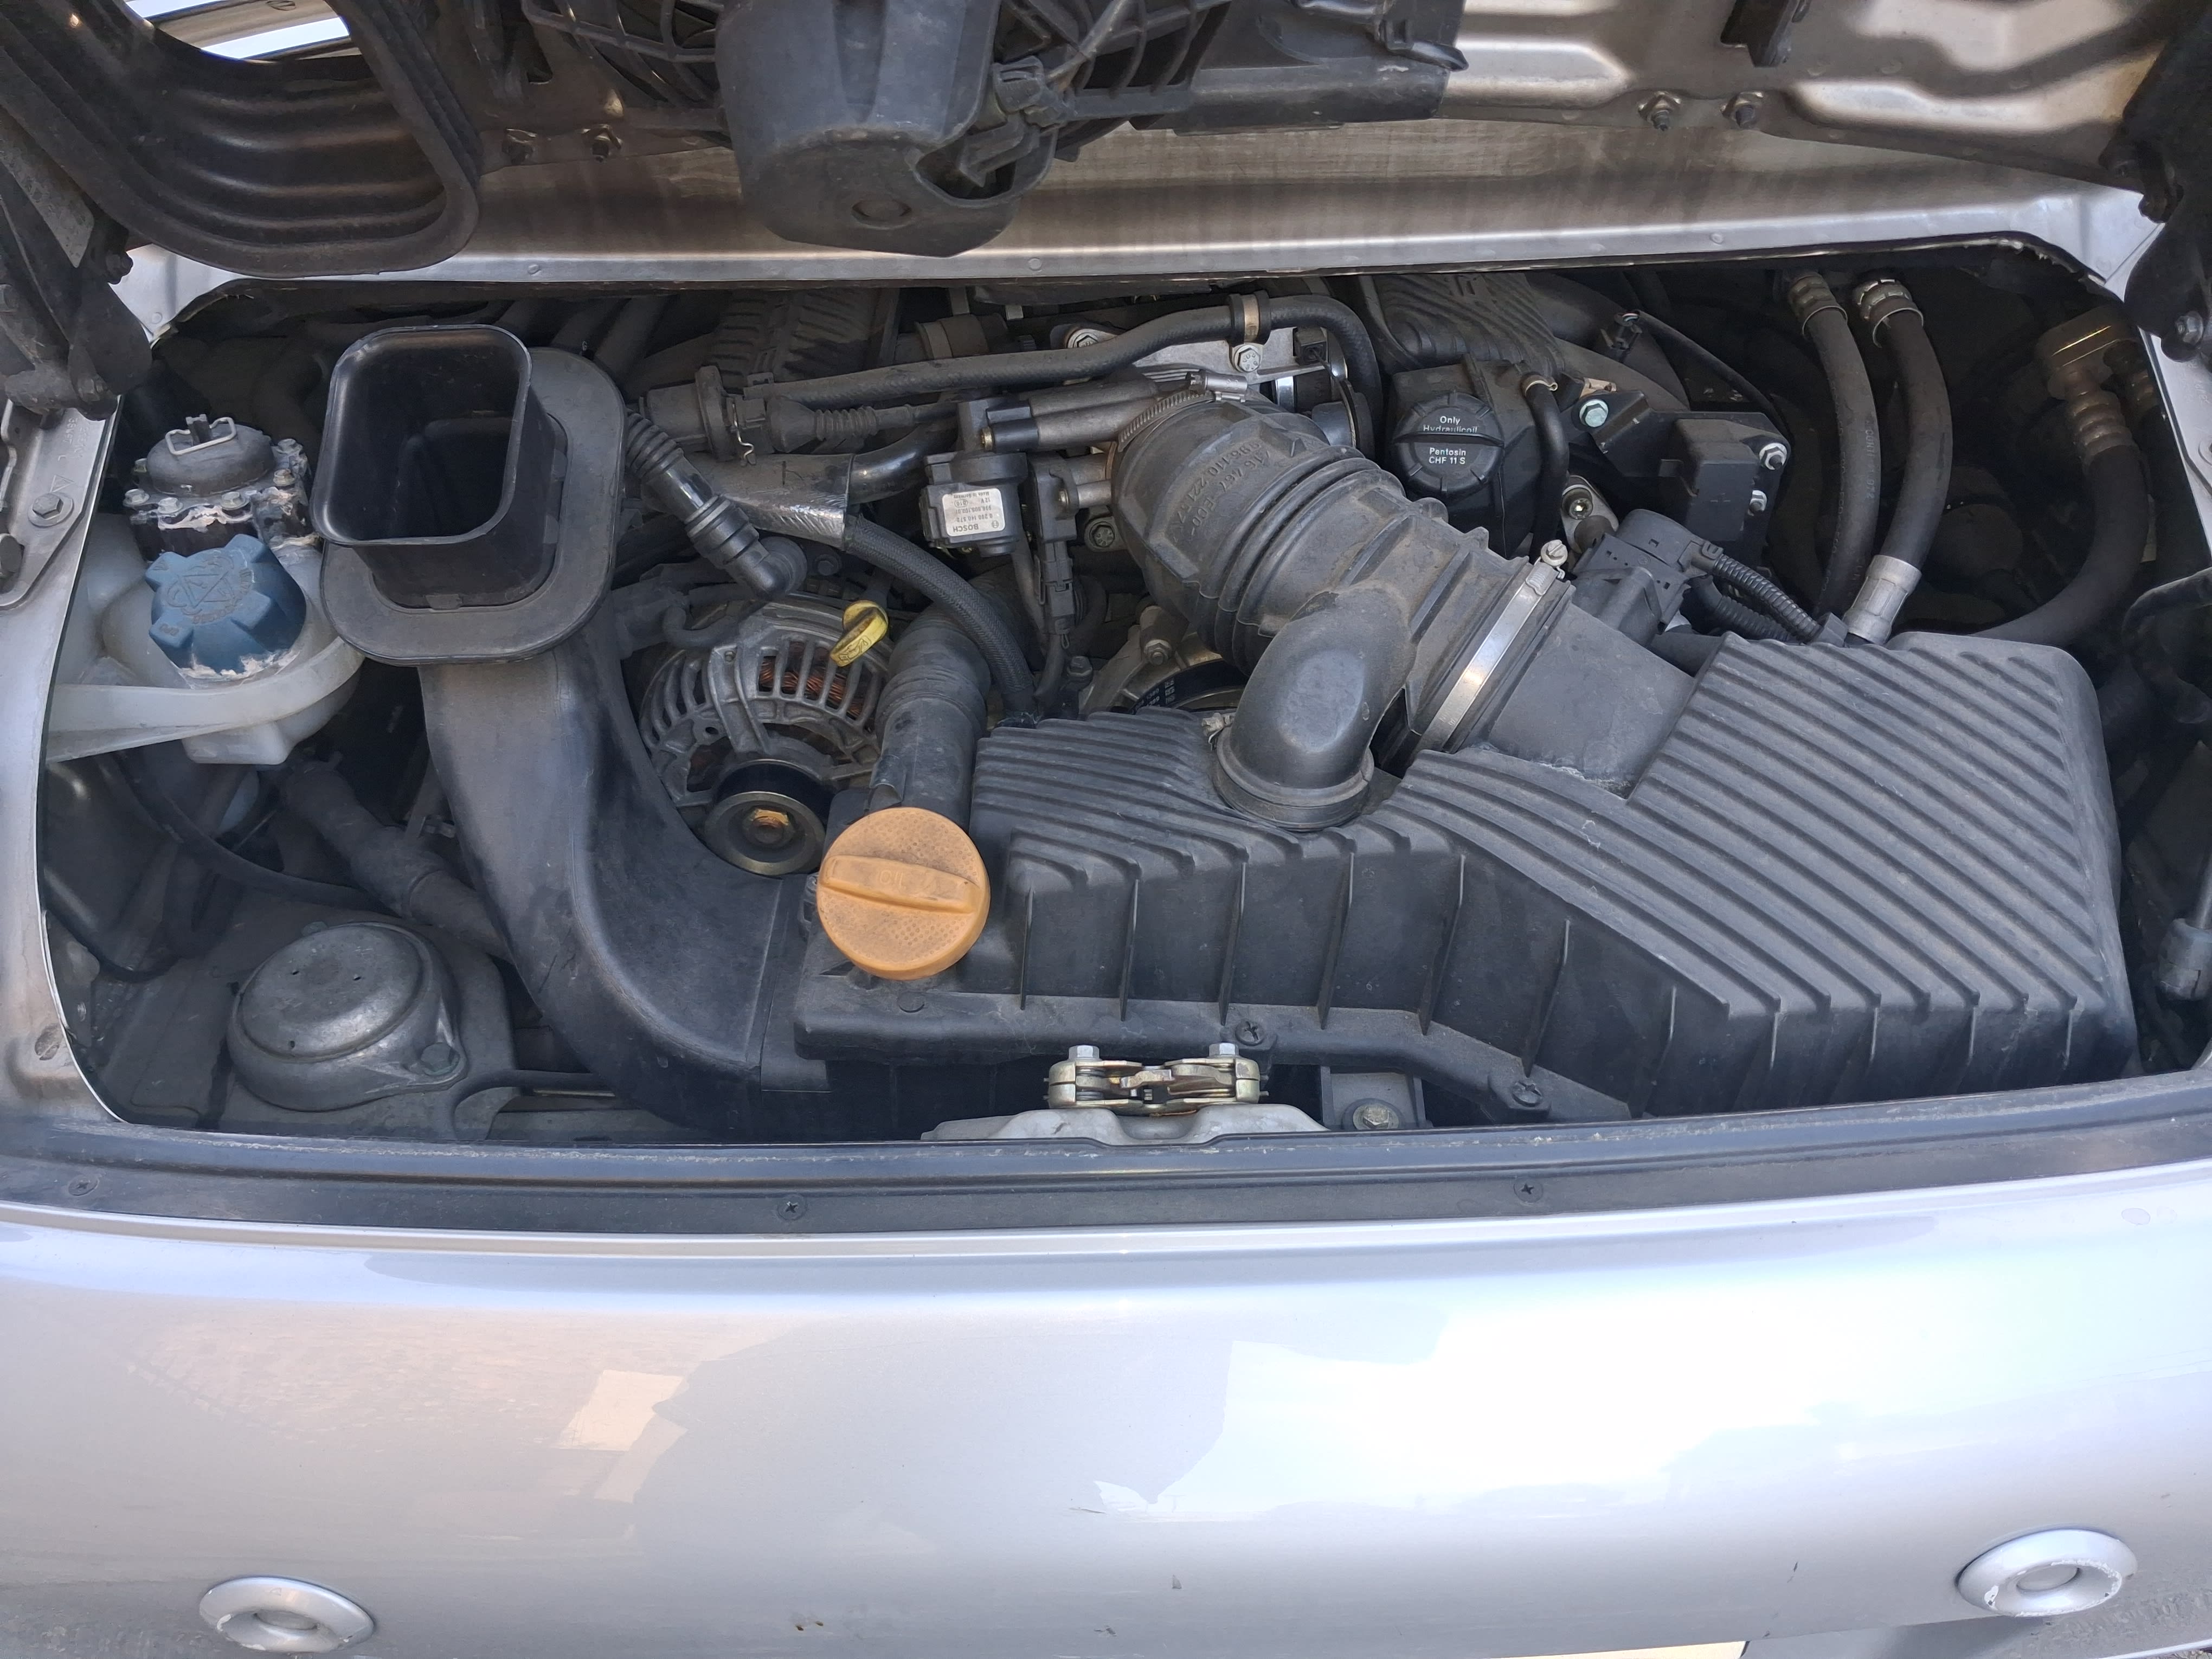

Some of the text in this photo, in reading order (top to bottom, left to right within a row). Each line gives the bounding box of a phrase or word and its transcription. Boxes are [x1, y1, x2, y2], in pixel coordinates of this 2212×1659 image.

[1440, 416, 1461, 425] Only
[1430, 447, 1466, 456] Pentosin
[953, 524, 979, 532] BOSCH
